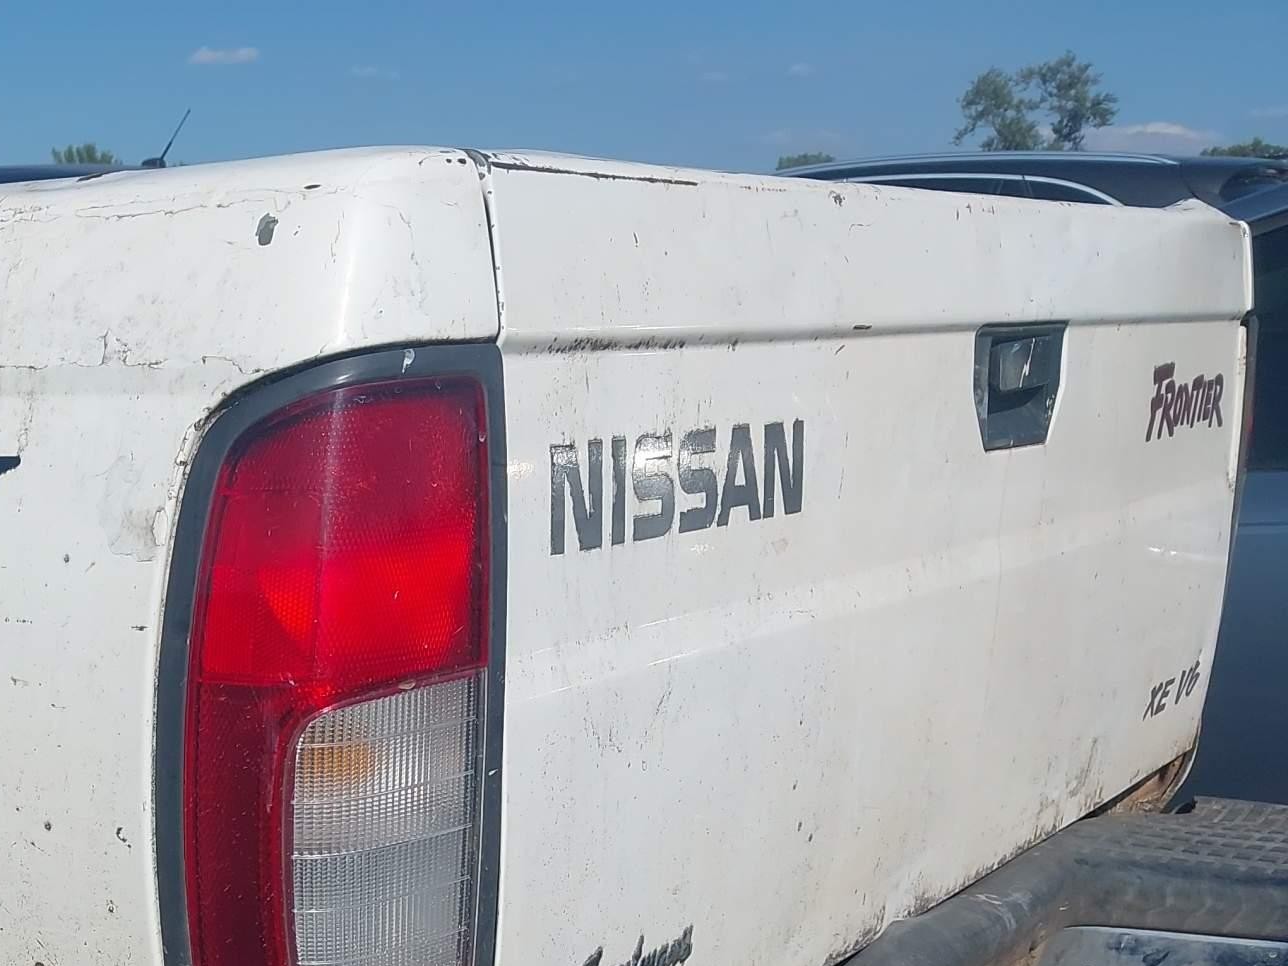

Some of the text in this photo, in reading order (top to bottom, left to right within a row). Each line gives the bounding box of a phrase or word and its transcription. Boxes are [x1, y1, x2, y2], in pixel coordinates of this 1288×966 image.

[550, 418, 805, 556] NISSAN
[1142, 660, 1201, 721] XE V6
